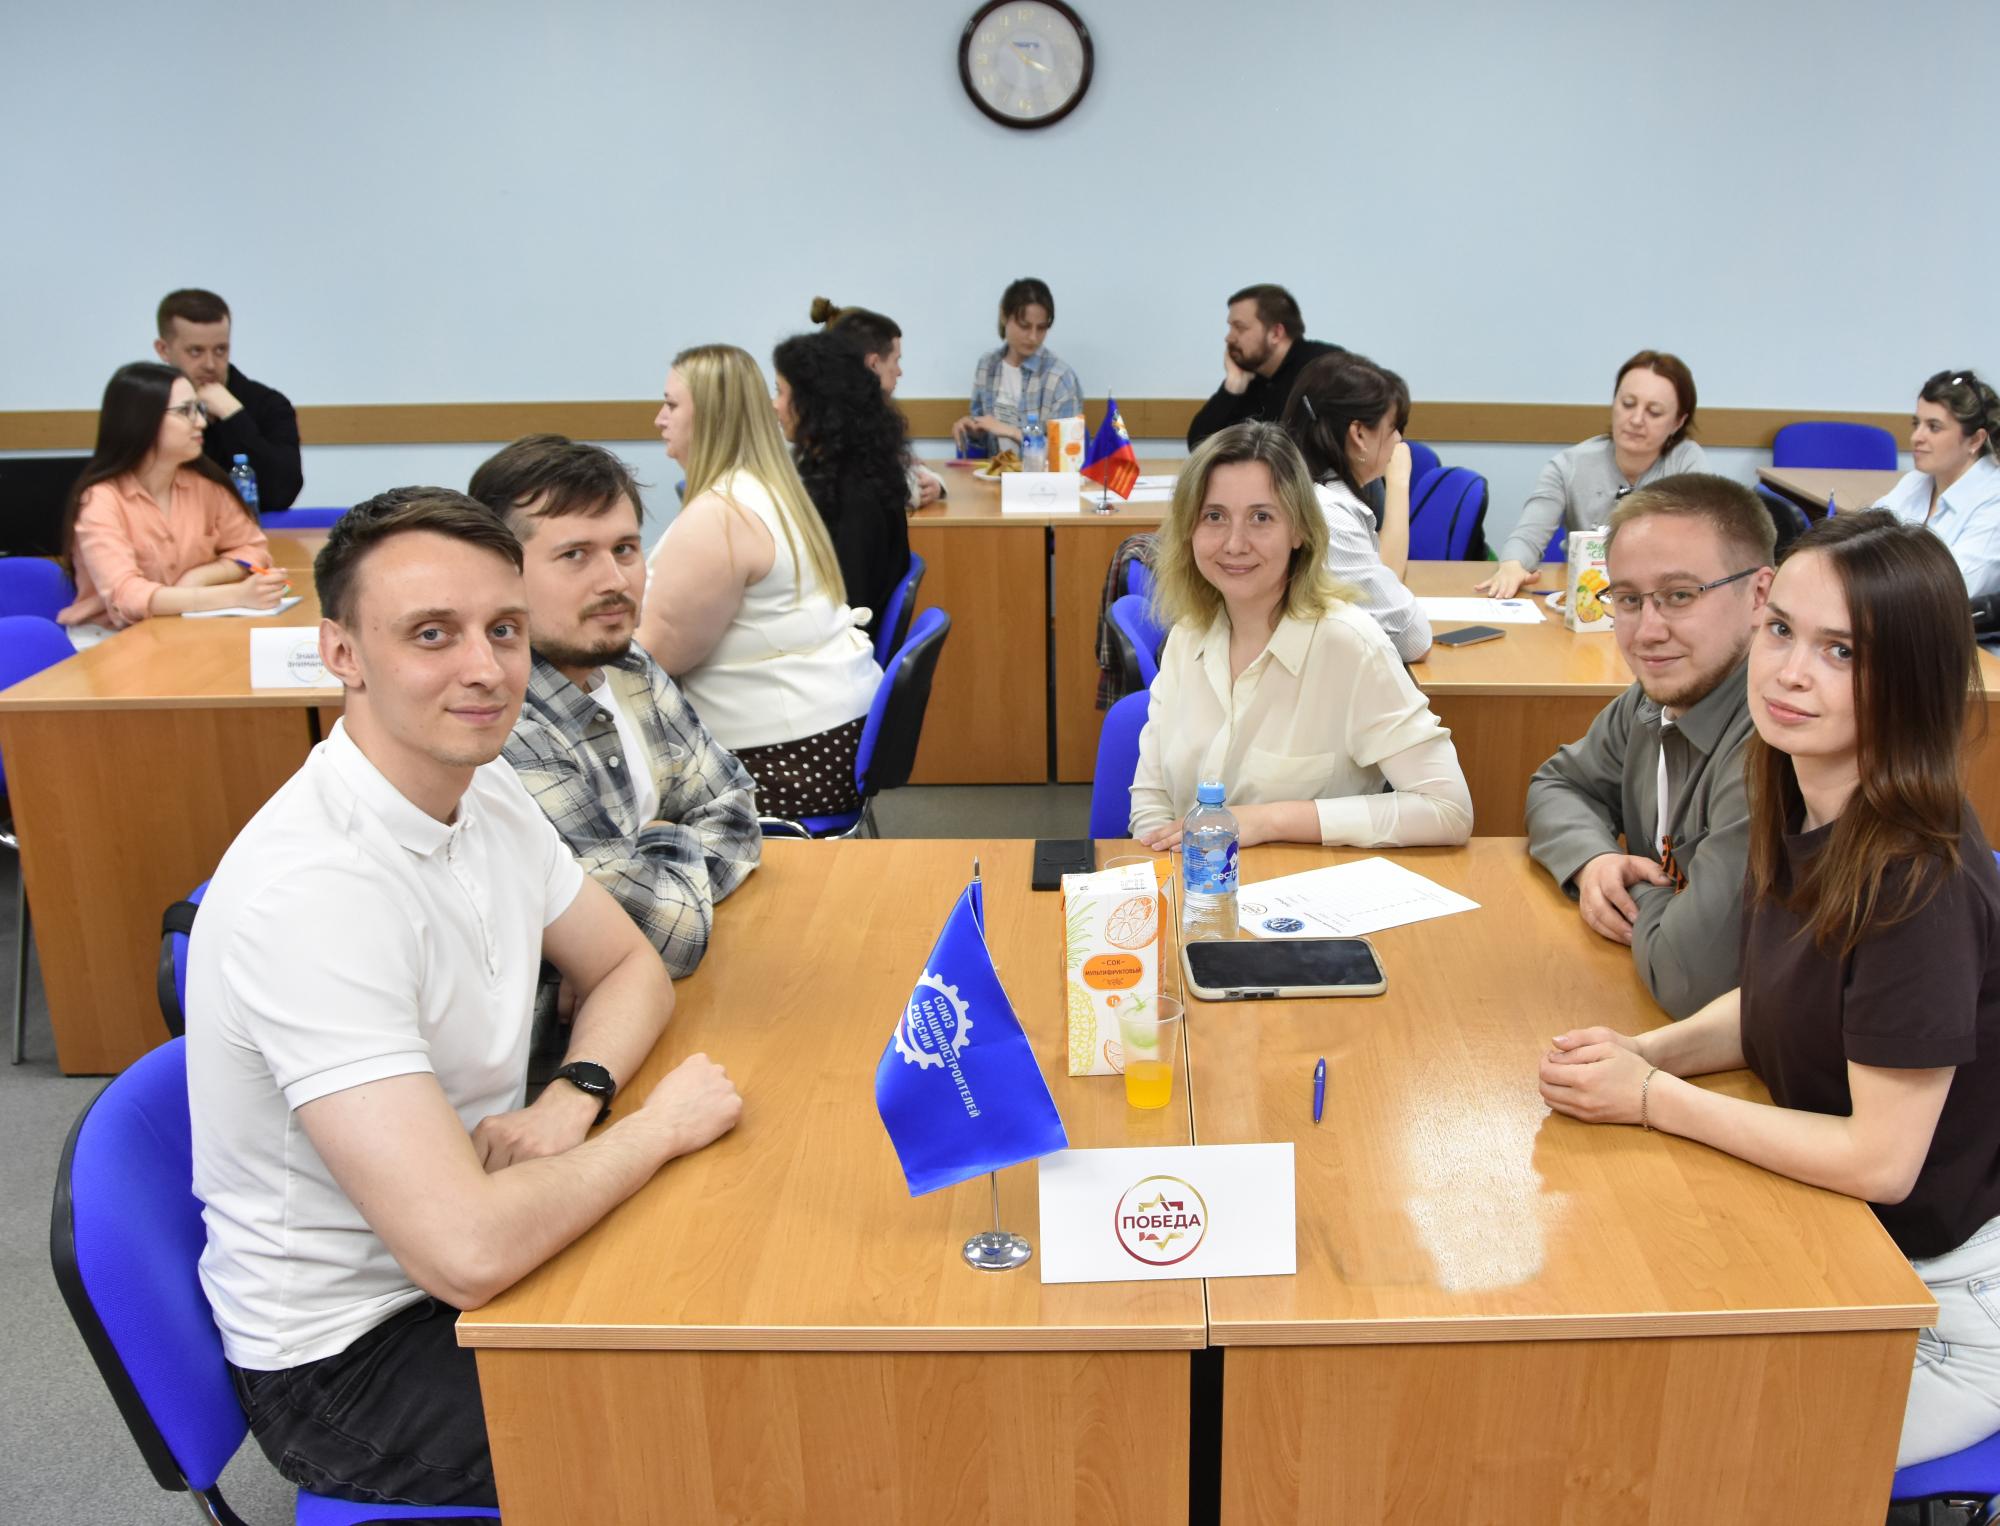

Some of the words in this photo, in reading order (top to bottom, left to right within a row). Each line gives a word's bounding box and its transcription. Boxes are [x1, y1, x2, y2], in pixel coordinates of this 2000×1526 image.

[911, 1004, 934, 1049] РОССИИ
[933, 995, 955, 1029] СОЮЗ
[921, 1000, 981, 1118] МАШИНОСТРОИТЕЛЕЙ
[1123, 1213, 1201, 1229] ПОБЕДА
